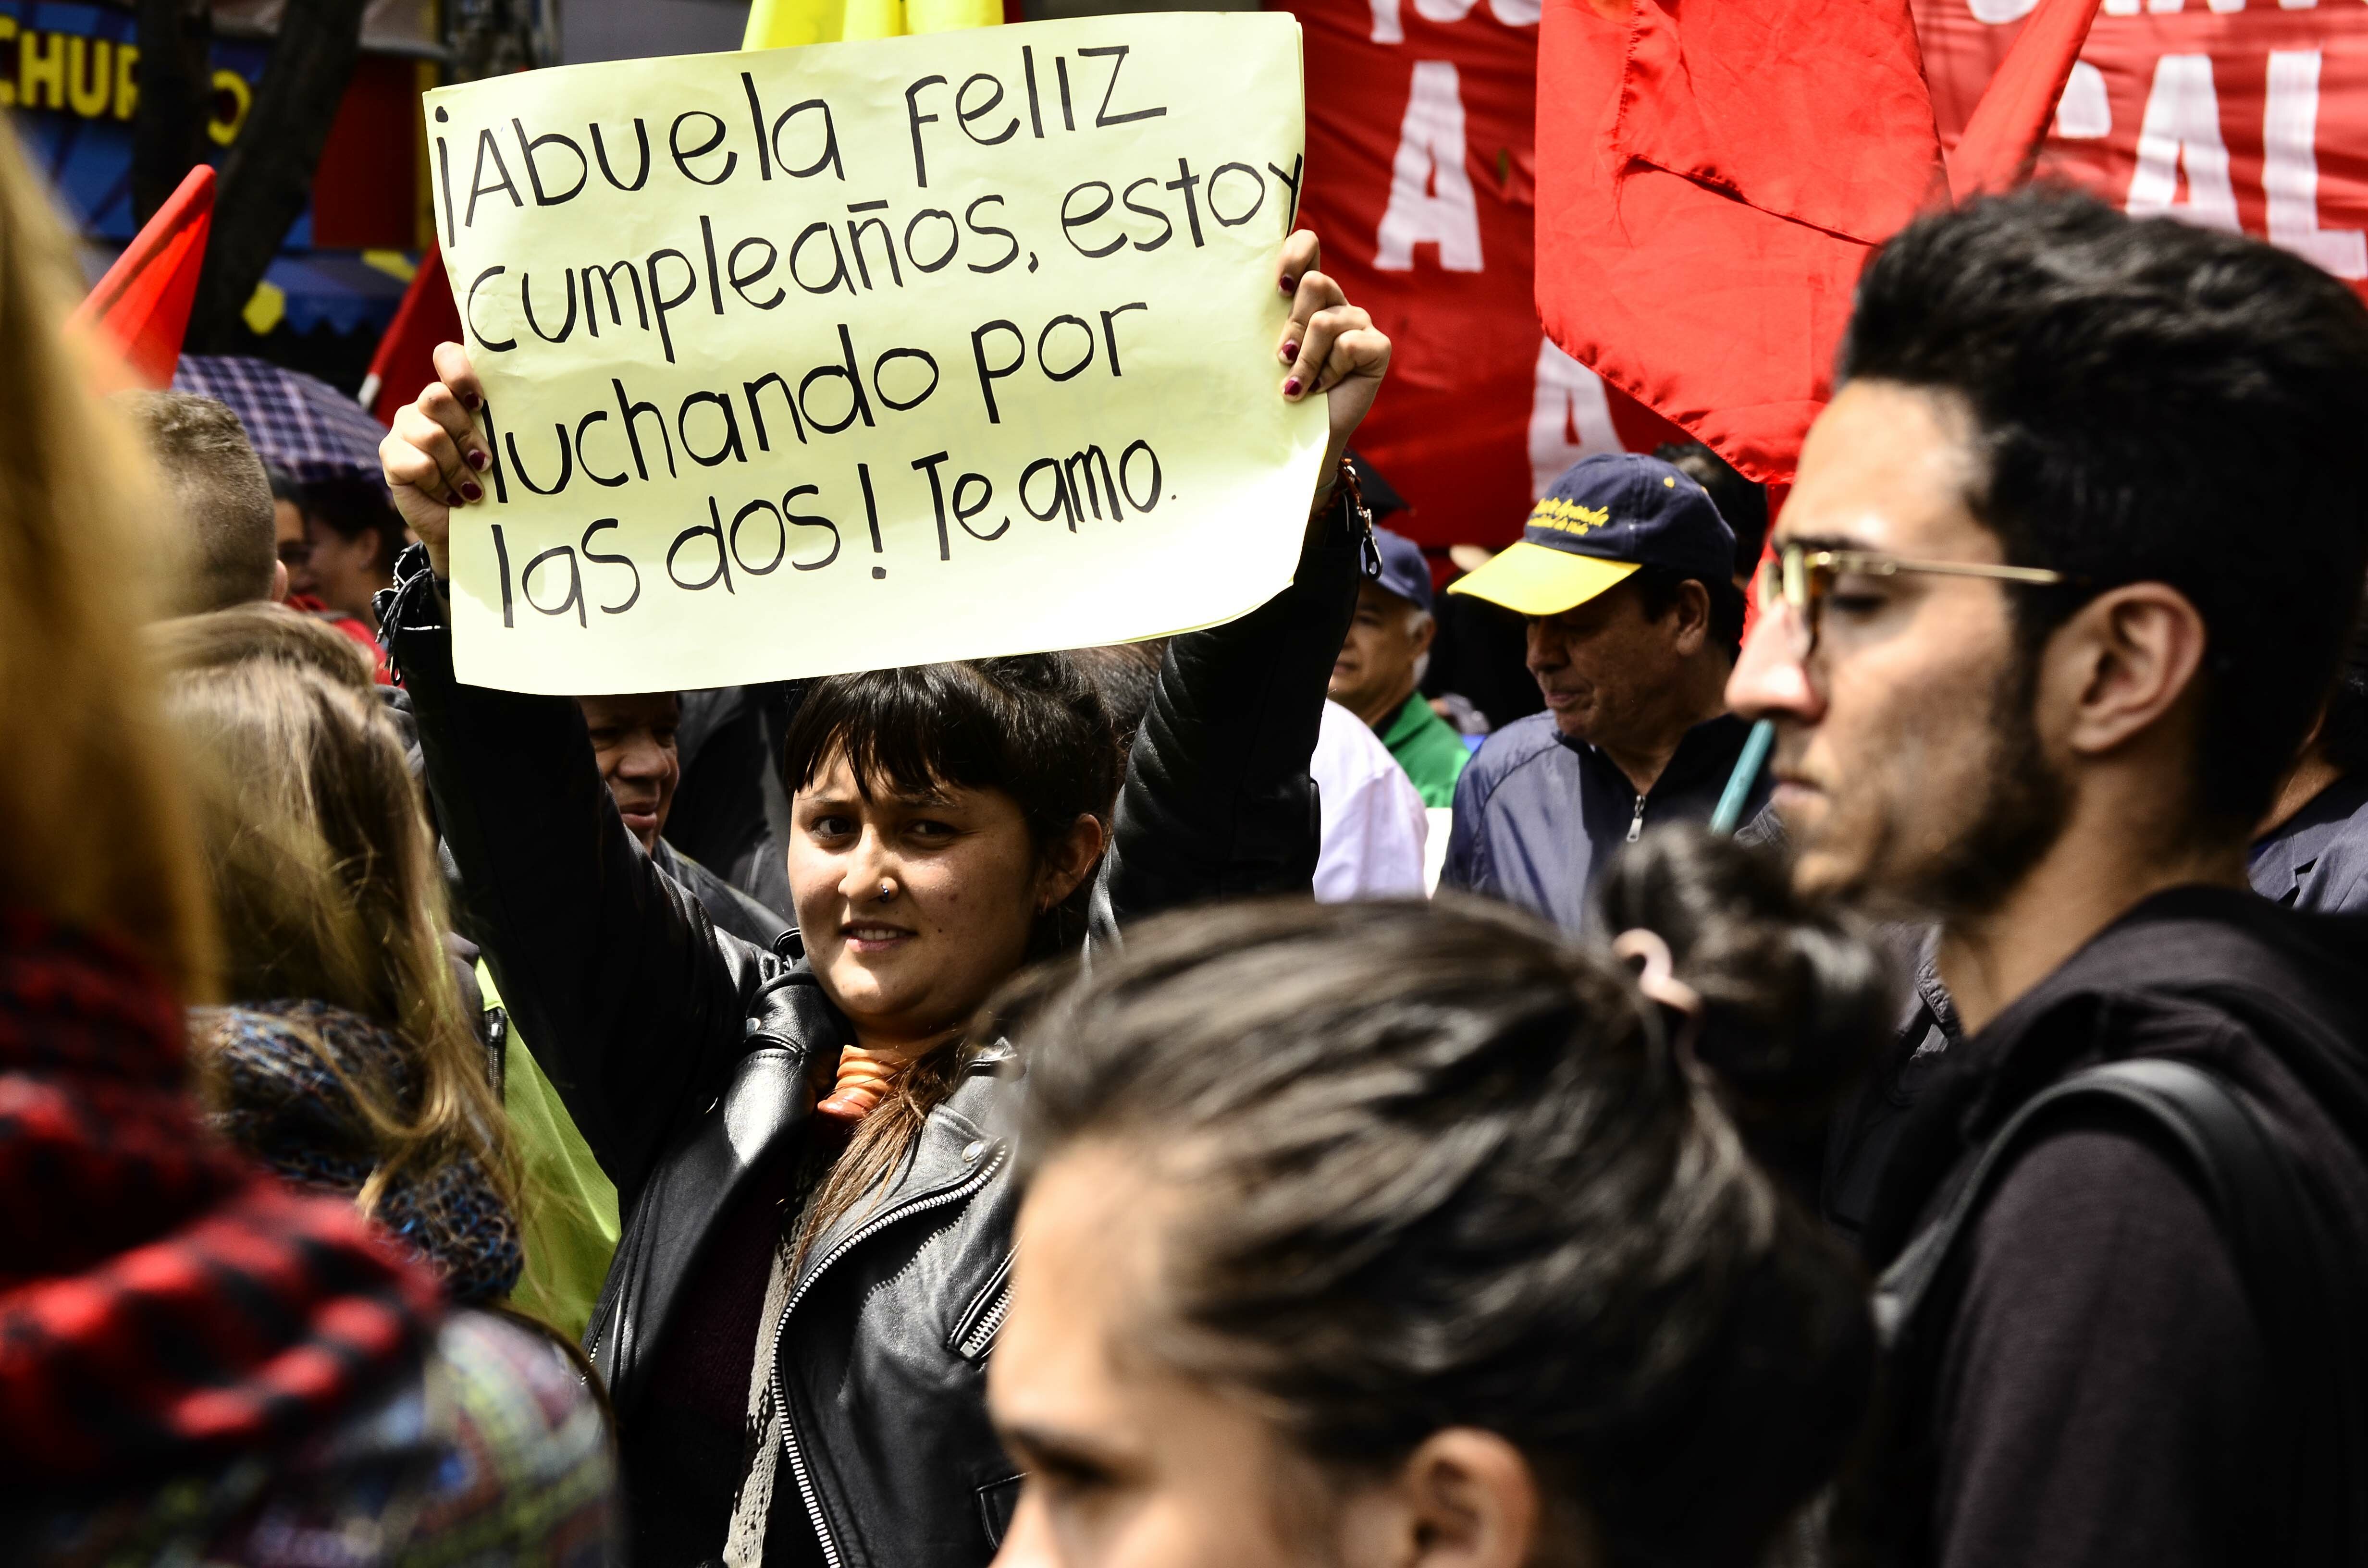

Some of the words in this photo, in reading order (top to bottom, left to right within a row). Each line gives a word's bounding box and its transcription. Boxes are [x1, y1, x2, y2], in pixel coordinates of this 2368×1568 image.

[435, 72, 846, 248] ¡Abuela
[468, 195, 1039, 364] cumpleaños,
[1061, 153, 1303, 258] estoy
[1372, 60, 1484, 272] A
[2056, 50, 2367, 280] AL
[481, 324, 939, 503] luchando
[971, 302, 1147, 424] por
[491, 518, 641, 628] las
[911, 450, 1011, 561] Te
